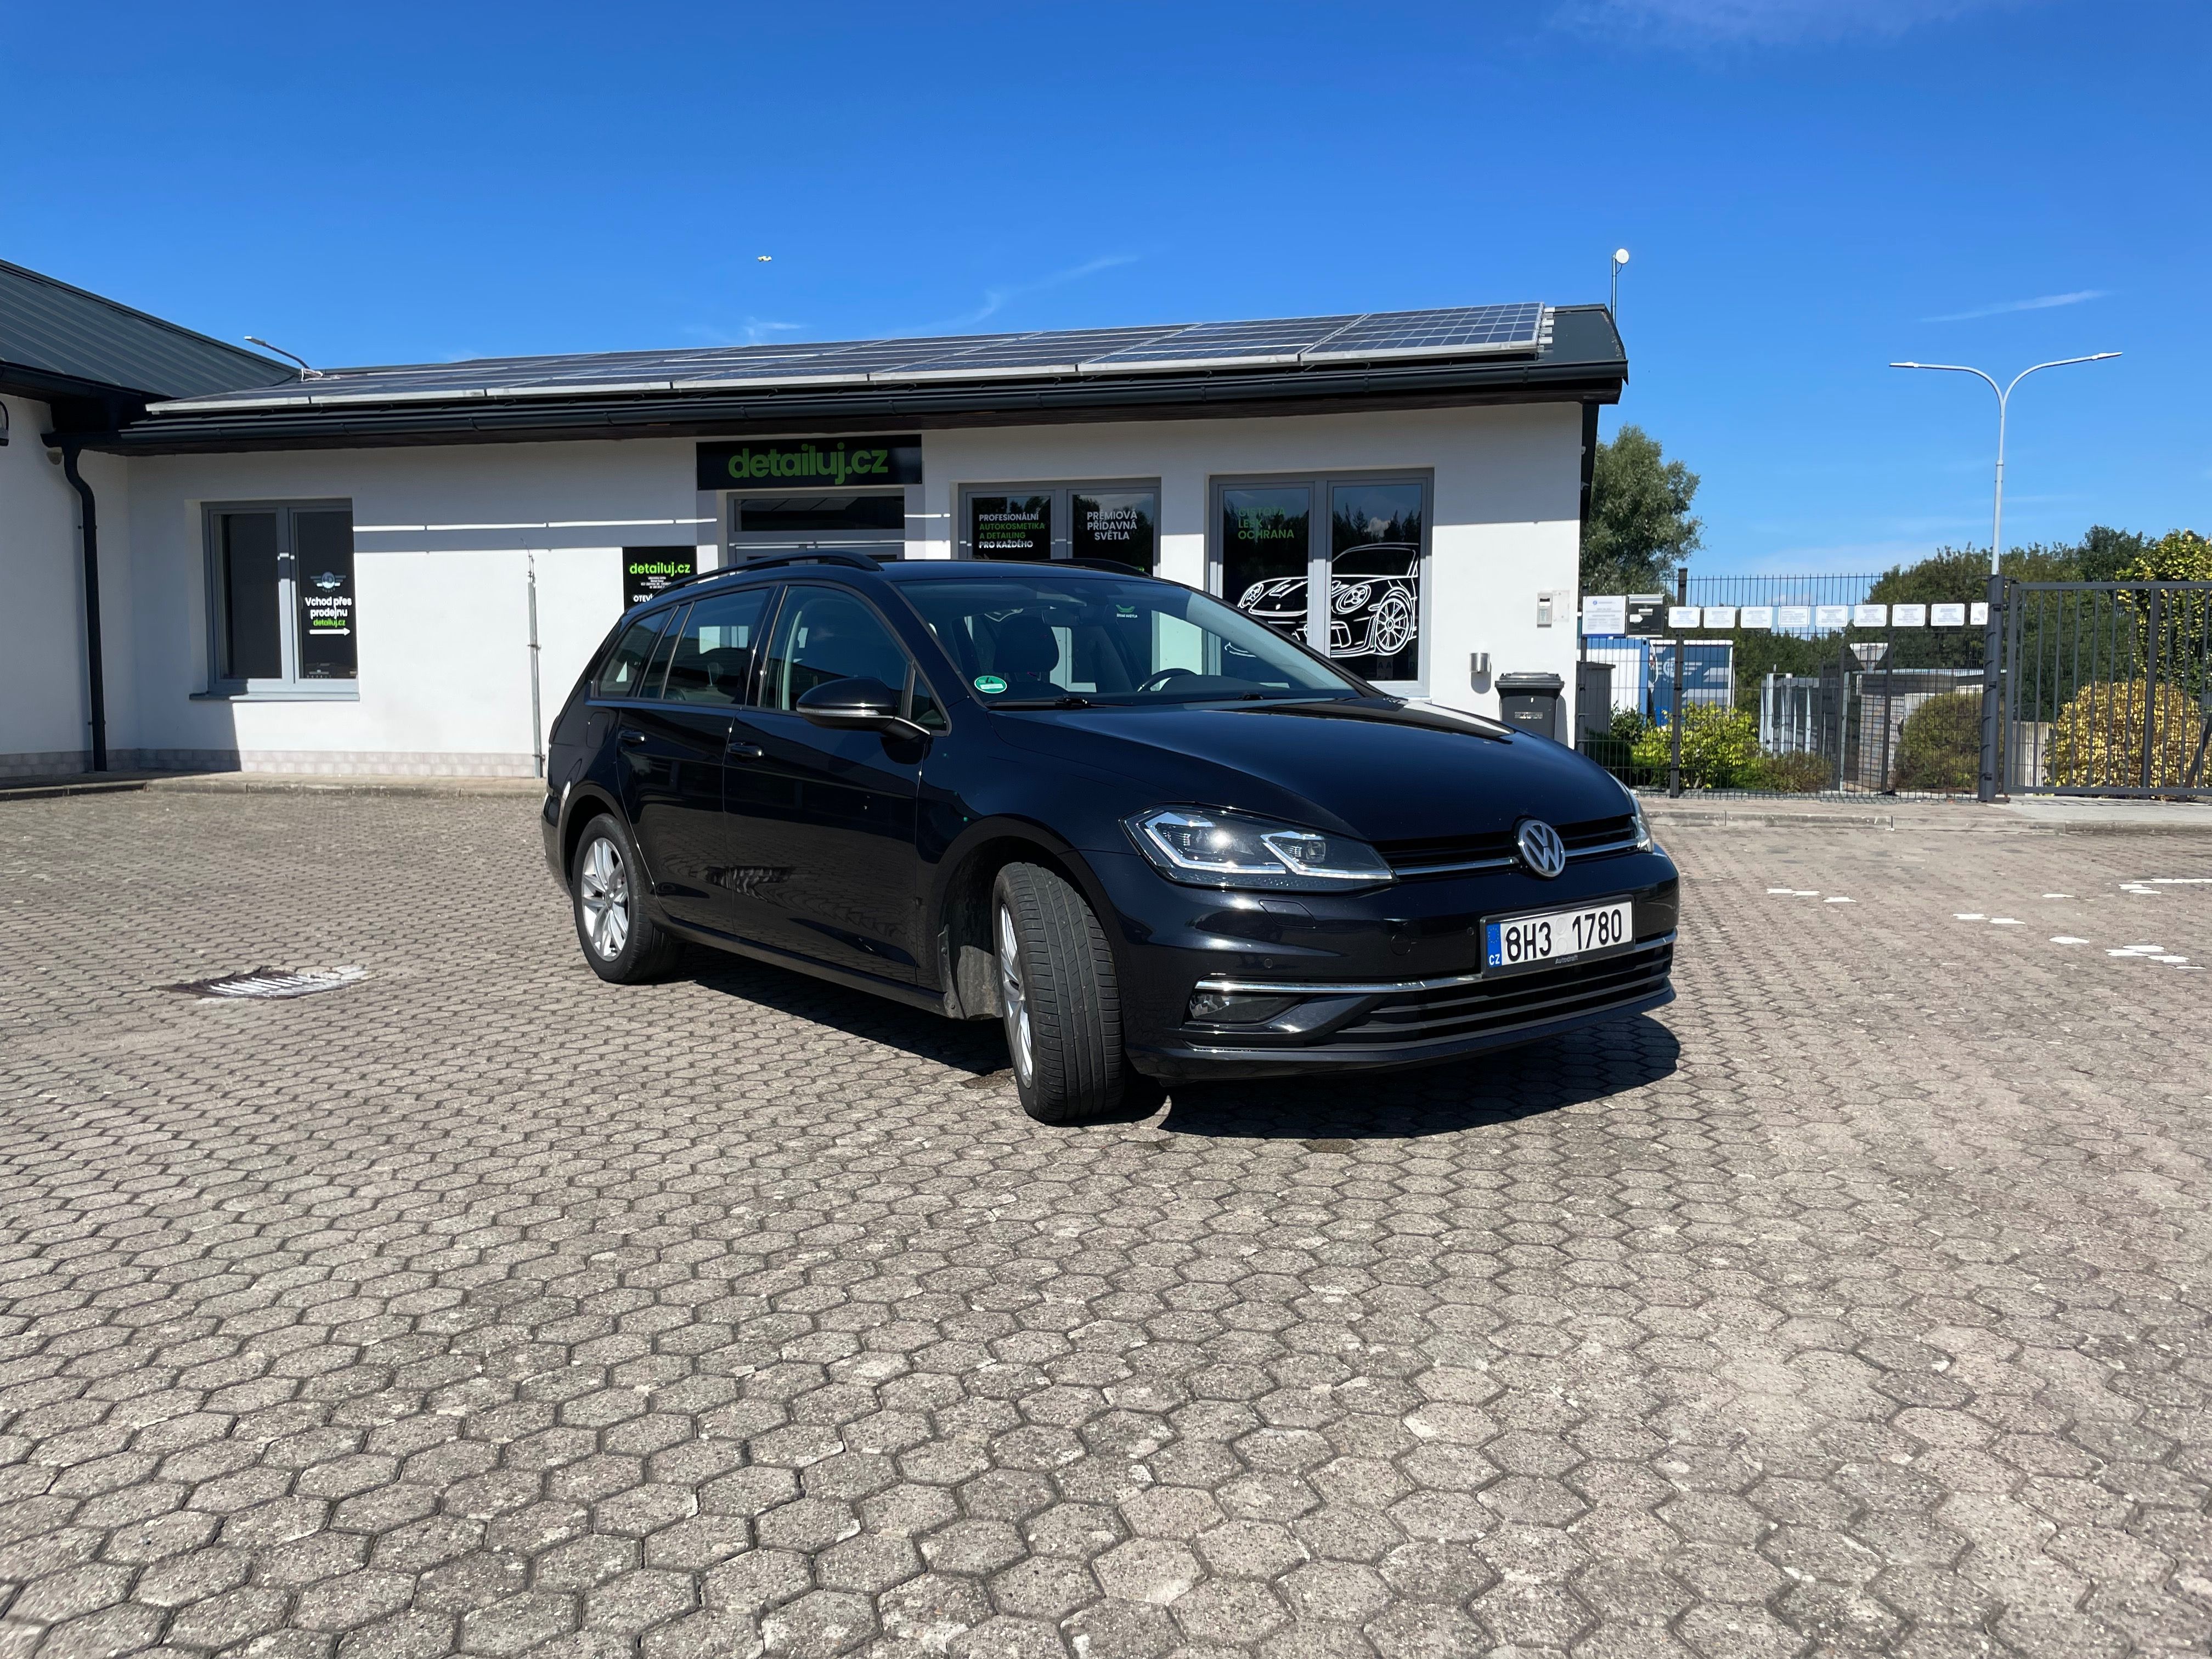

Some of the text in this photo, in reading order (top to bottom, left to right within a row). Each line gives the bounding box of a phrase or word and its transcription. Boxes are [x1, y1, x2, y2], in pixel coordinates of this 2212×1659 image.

[728, 442, 889, 485] detailuj.cz
[979, 512, 1039, 521] PROFESIONÁLNÍ
[979, 522, 1045, 531] AUTOKOSMETIKA
[1087, 520, 1137, 531] PŘÍDAVNÁ
[1238, 519, 1262, 528] LESK
[1094, 531, 1130, 541] SVĚTLA
[1238, 529, 1295, 540] OCHRANA
[996, 539, 1034, 548] KAŽDÉHO
[629, 562, 691, 577] detailuj.cz
[305, 596, 352, 608] Vchod přes
[310, 607, 348, 619] prodejnu
[313, 618, 346, 628] detailuj.cz
[1506, 909, 1622, 962] 8H3 1780
[1489, 953, 1501, 966] CZ
